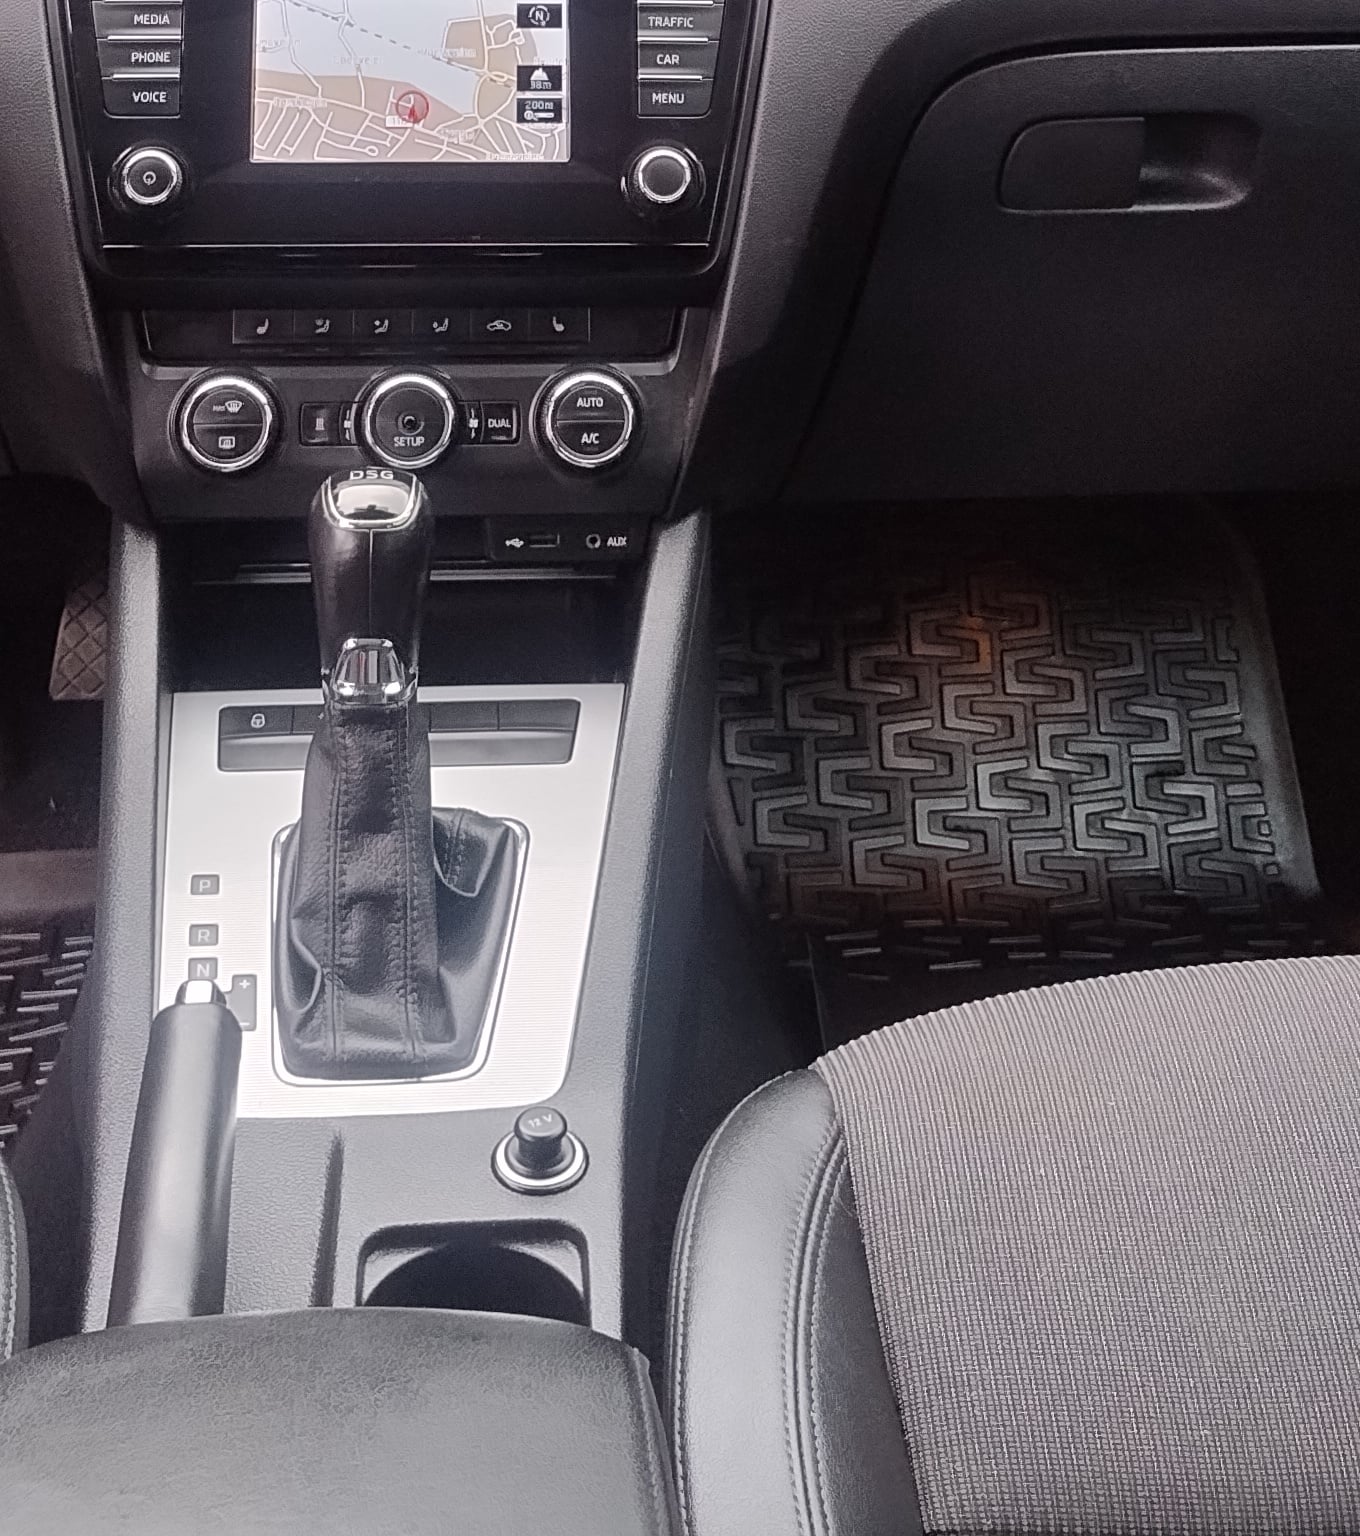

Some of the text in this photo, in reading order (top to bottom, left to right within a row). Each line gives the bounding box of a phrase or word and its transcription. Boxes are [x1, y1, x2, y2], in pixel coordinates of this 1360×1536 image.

[133, 14, 171, 25] MEDIA
[535, 10, 544, 21] N
[647, 16, 694, 28] TRAFFIC
[131, 51, 171, 63] PHONE
[656, 54, 680, 65] CAR
[132, 91, 167, 103] VOICE
[652, 93, 685, 104] MENU
[576, 397, 604, 408] AUTO
[487, 418, 511, 428] DUAL
[393, 436, 425, 447] SETUP
[581, 433, 600, 444] A/C
[349, 470, 394, 480] DSG
[607, 534, 627, 547] AUX
[199, 879, 211, 893] P
[197, 929, 210, 943] R
[196, 963, 210, 977] N
